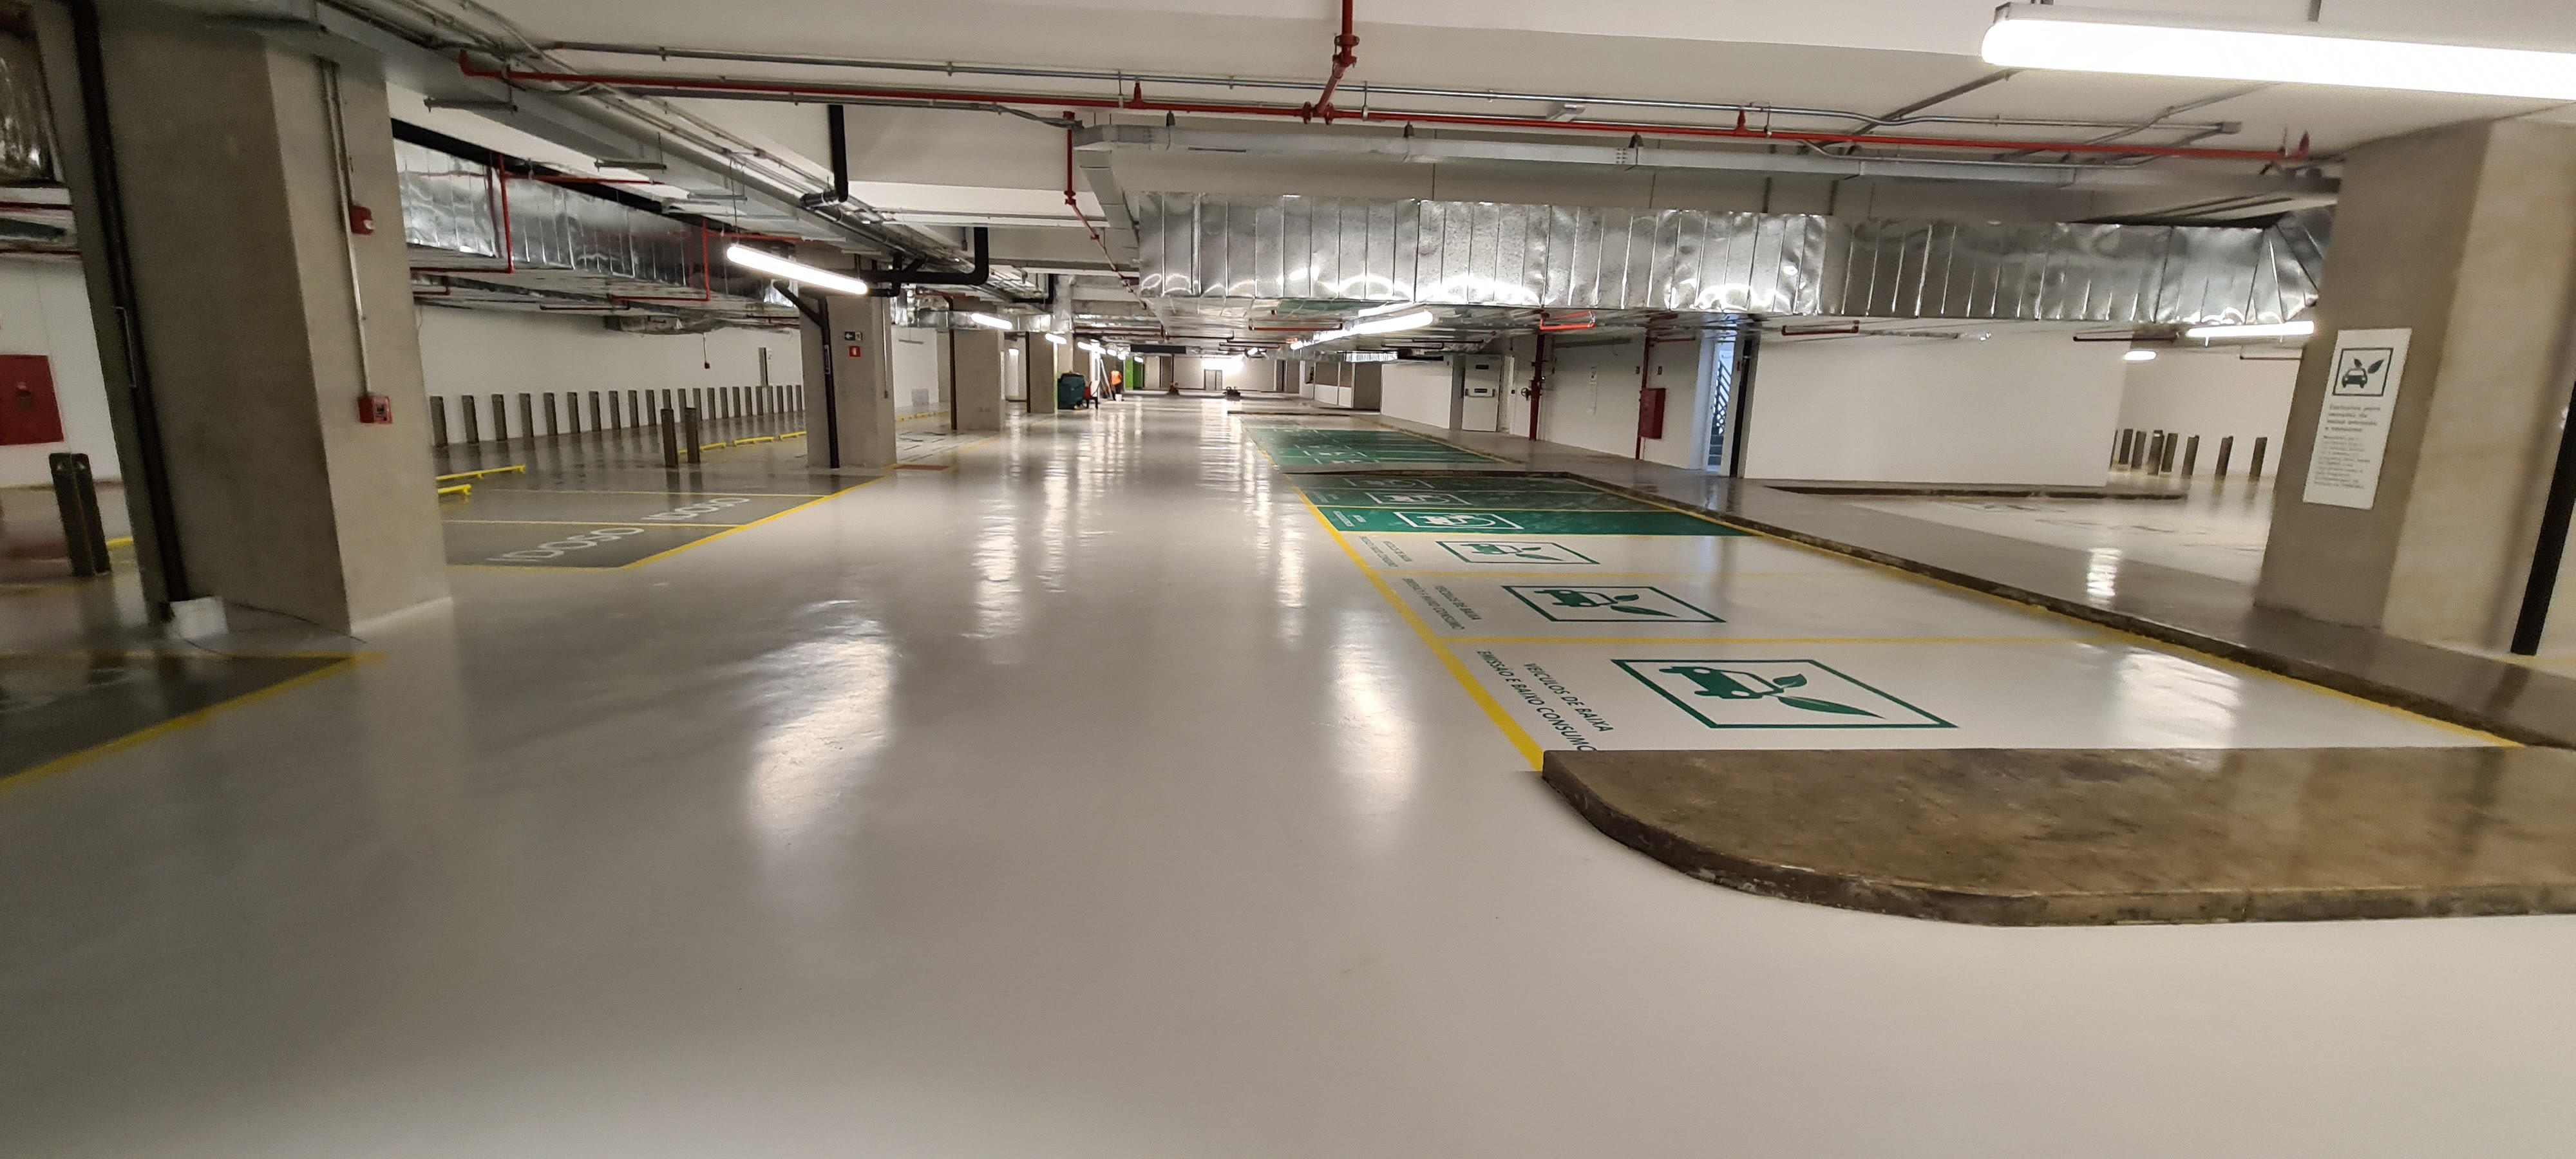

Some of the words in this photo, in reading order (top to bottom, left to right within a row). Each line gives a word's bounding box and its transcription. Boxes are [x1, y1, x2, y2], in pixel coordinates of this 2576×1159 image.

[641, 497, 750, 520] IDOSO
[485, 527, 644, 561] IDOSO
[1511, 684, 1545, 705] BAIXO
[1560, 697, 1585, 706] DE
[1575, 708, 1614, 731] BAIXA
